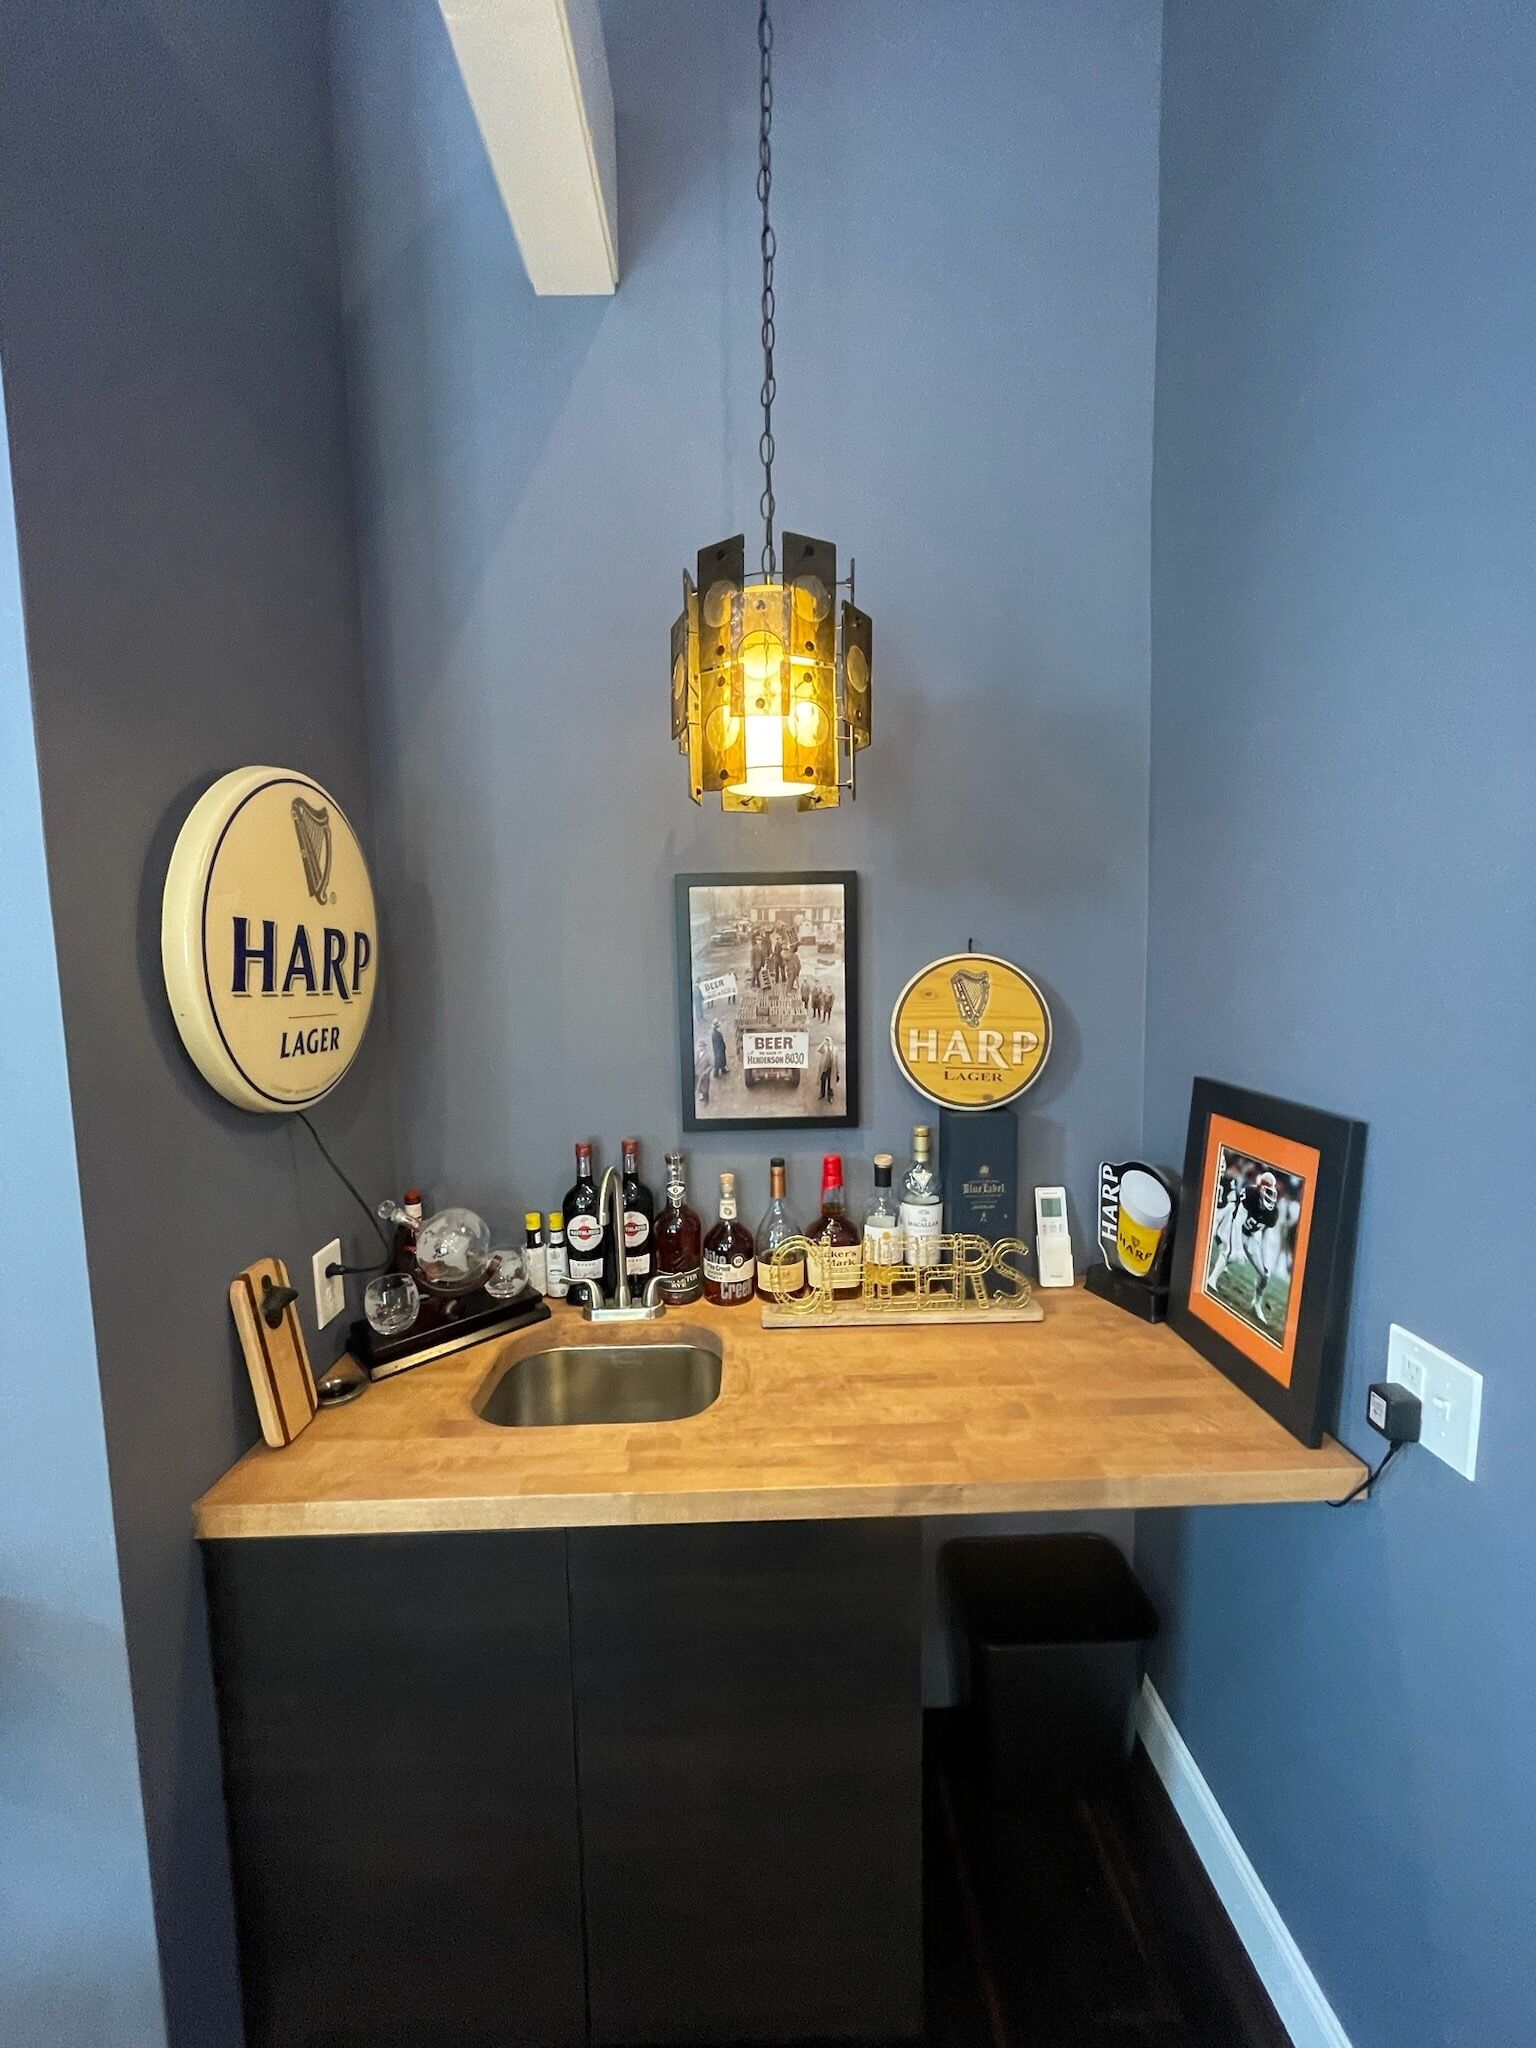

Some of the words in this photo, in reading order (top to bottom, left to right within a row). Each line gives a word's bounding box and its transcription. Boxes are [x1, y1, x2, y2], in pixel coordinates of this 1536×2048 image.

[231, 916, 372, 1003] HARP
[280, 1027, 340, 1059] LAGER
[784, 1052, 805, 1065] 8030
[908, 1028, 1040, 1069] HARP
[943, 1070, 1003, 1083] LAGER
[1101, 1164, 1121, 1243] HARP
[1119, 1232, 1153, 1262] HARP
